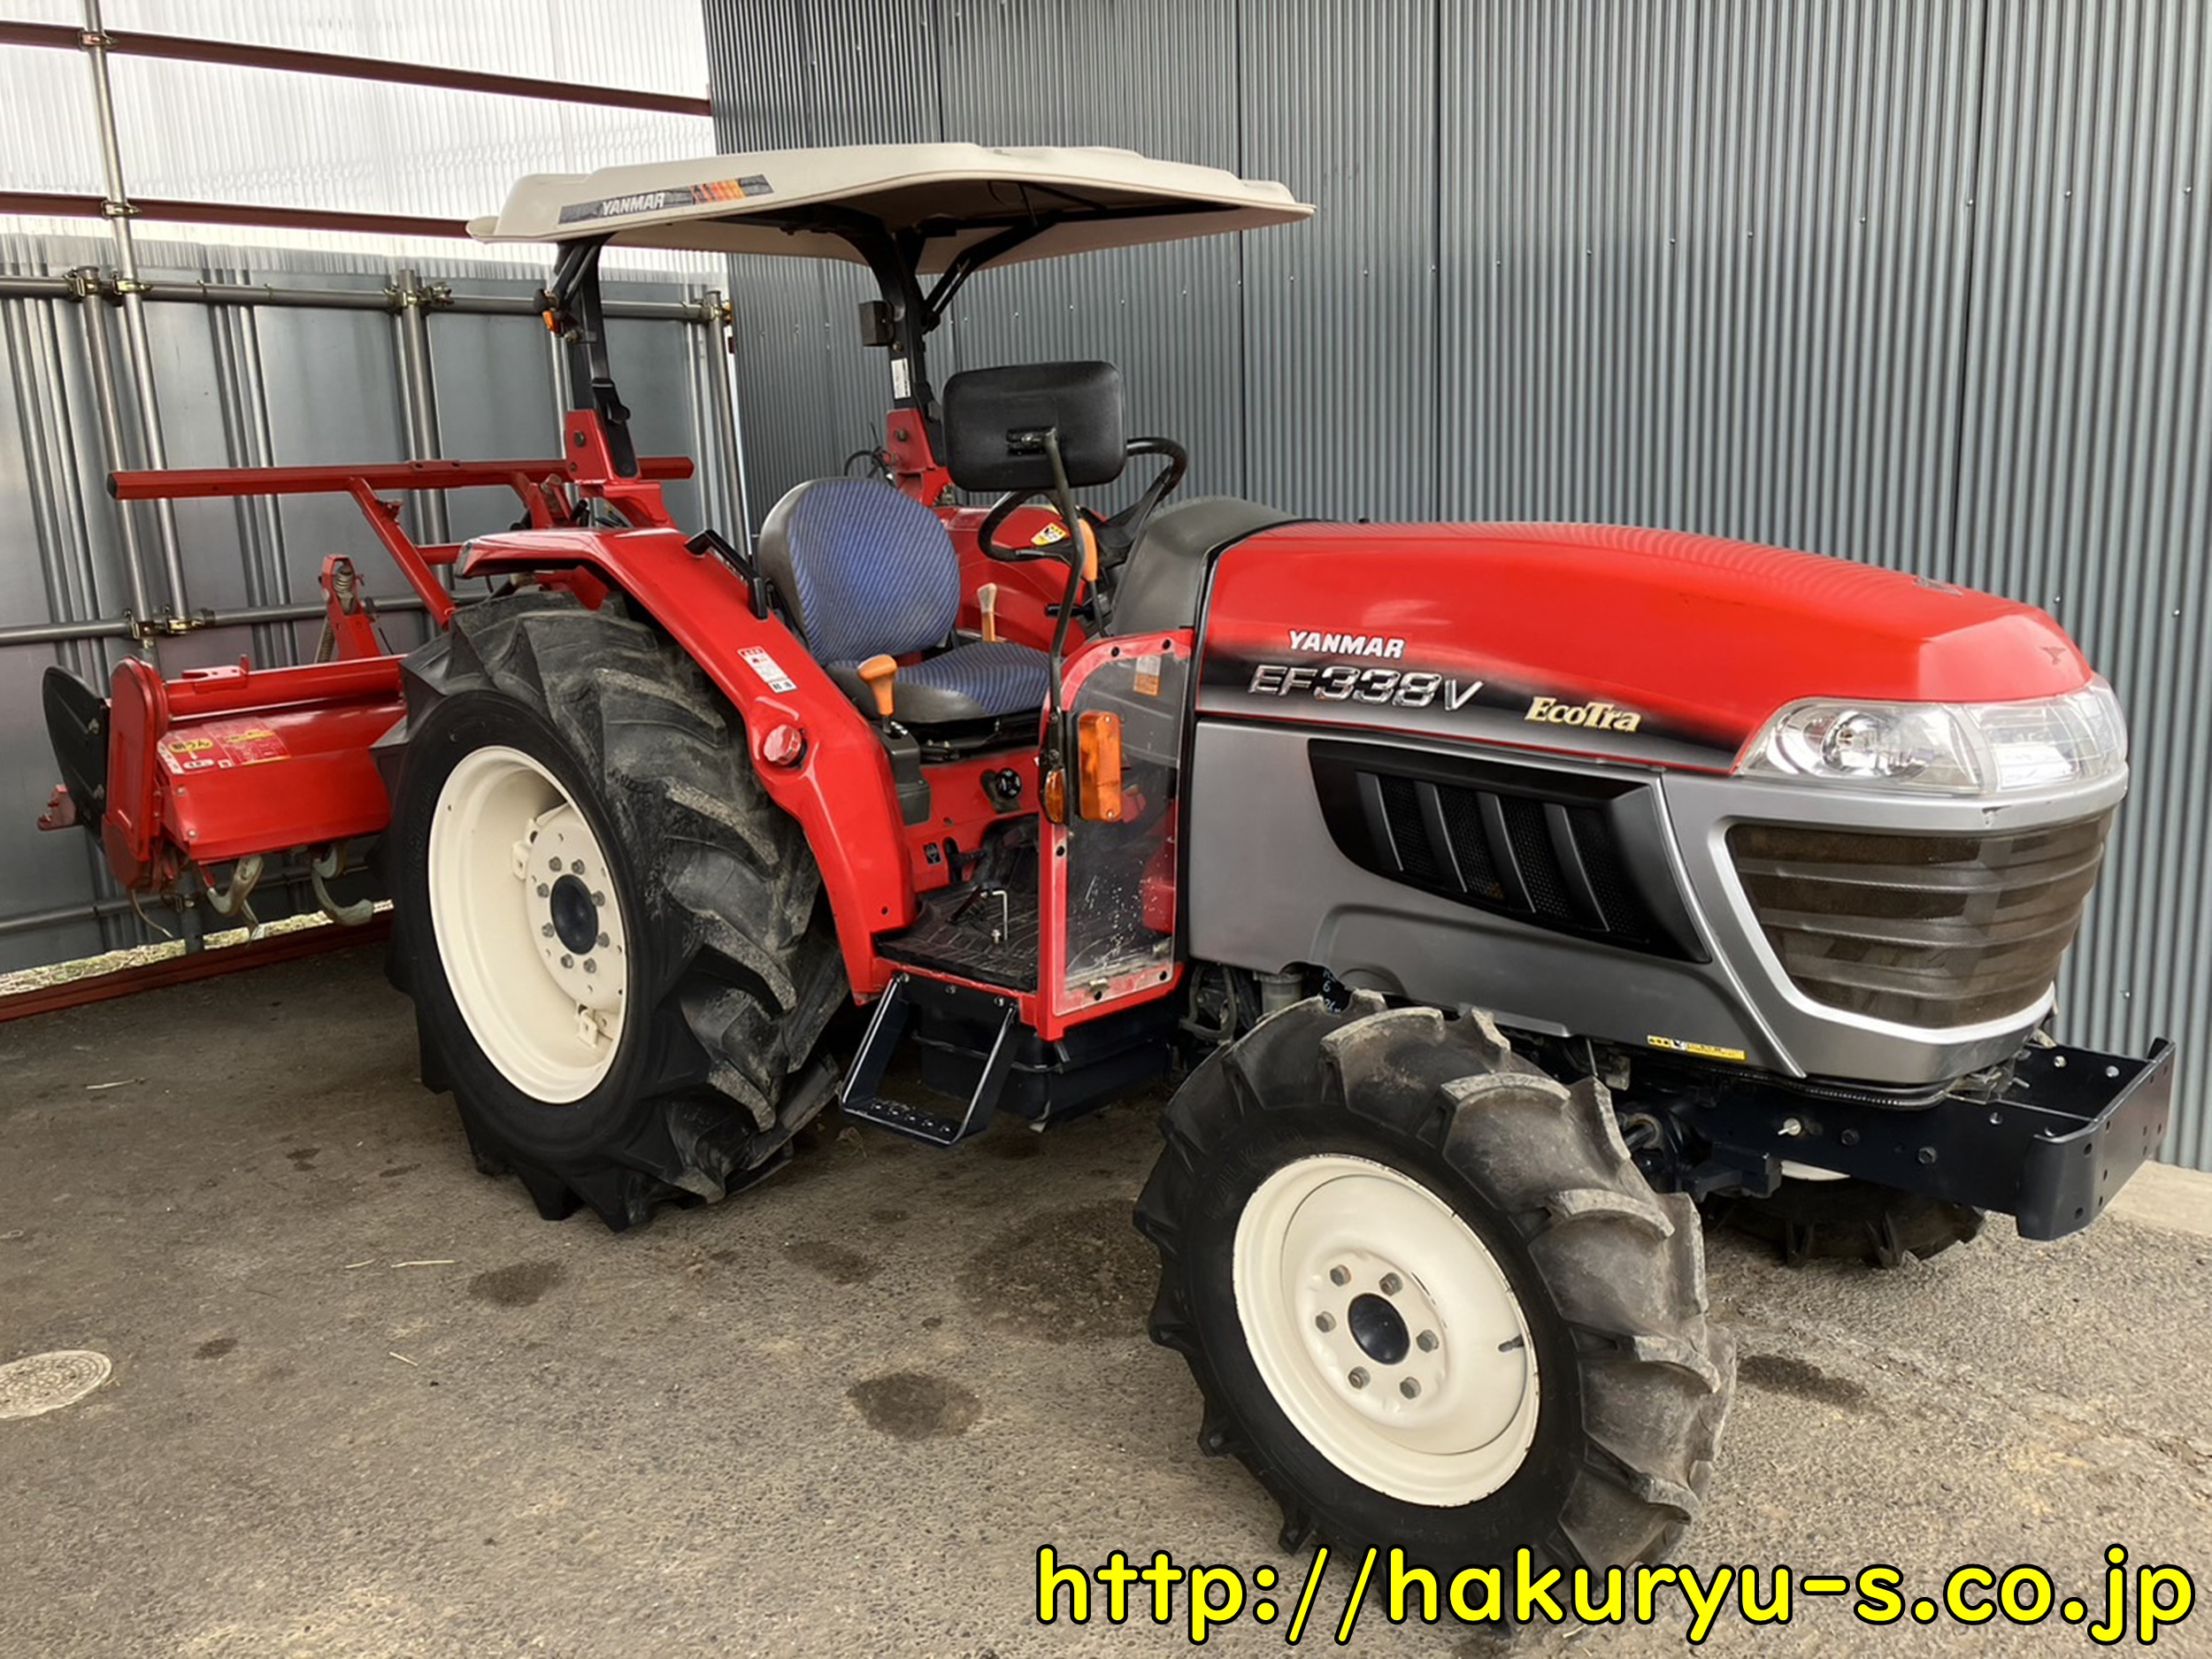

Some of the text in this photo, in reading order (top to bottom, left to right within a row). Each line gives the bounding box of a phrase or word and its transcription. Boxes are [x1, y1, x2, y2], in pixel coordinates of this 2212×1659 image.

[601, 191, 664, 217] YANMAR
[1288, 629, 1406, 659] YANMAR
[1248, 664, 1484, 711] EF338V
[1524, 695, 1641, 733] EcoTra
